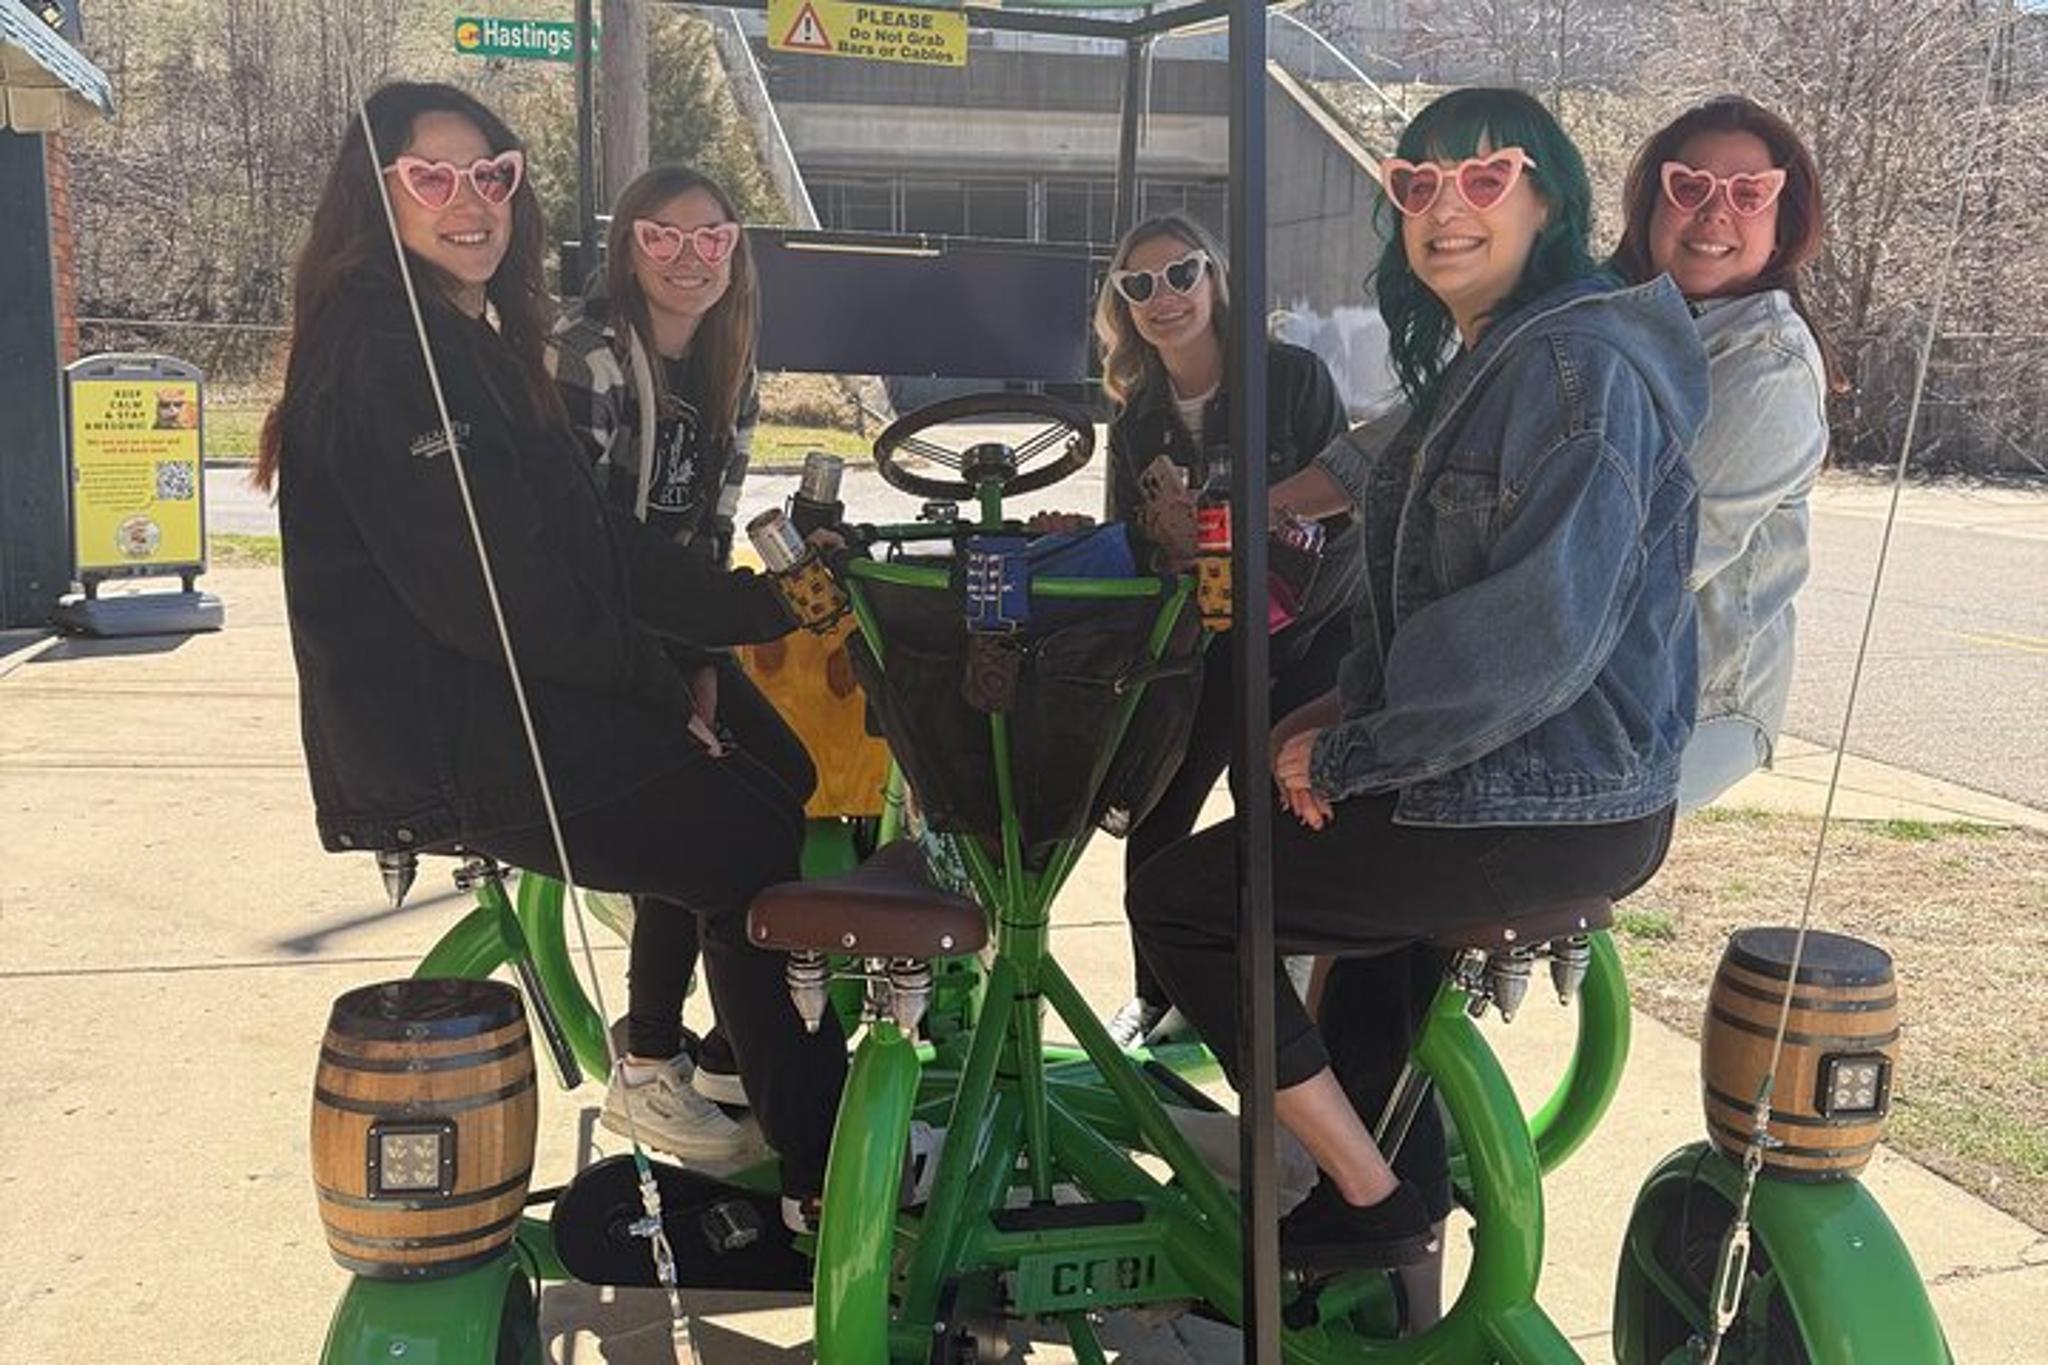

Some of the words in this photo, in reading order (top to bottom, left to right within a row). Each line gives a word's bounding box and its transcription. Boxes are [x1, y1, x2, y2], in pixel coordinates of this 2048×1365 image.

[856, 8, 934, 29] PLEASE
[483, 18, 573, 55] Hastings
[850, 27, 871, 40] Do
[875, 29, 903, 44] Not
[907, 31, 946, 46] Grab
[838, 41, 874, 55] Bars
[878, 46, 895, 57] or
[901, 46, 954, 63] Cables
[110, 401, 143, 410] CALM
[117, 411, 146, 419] STAY
